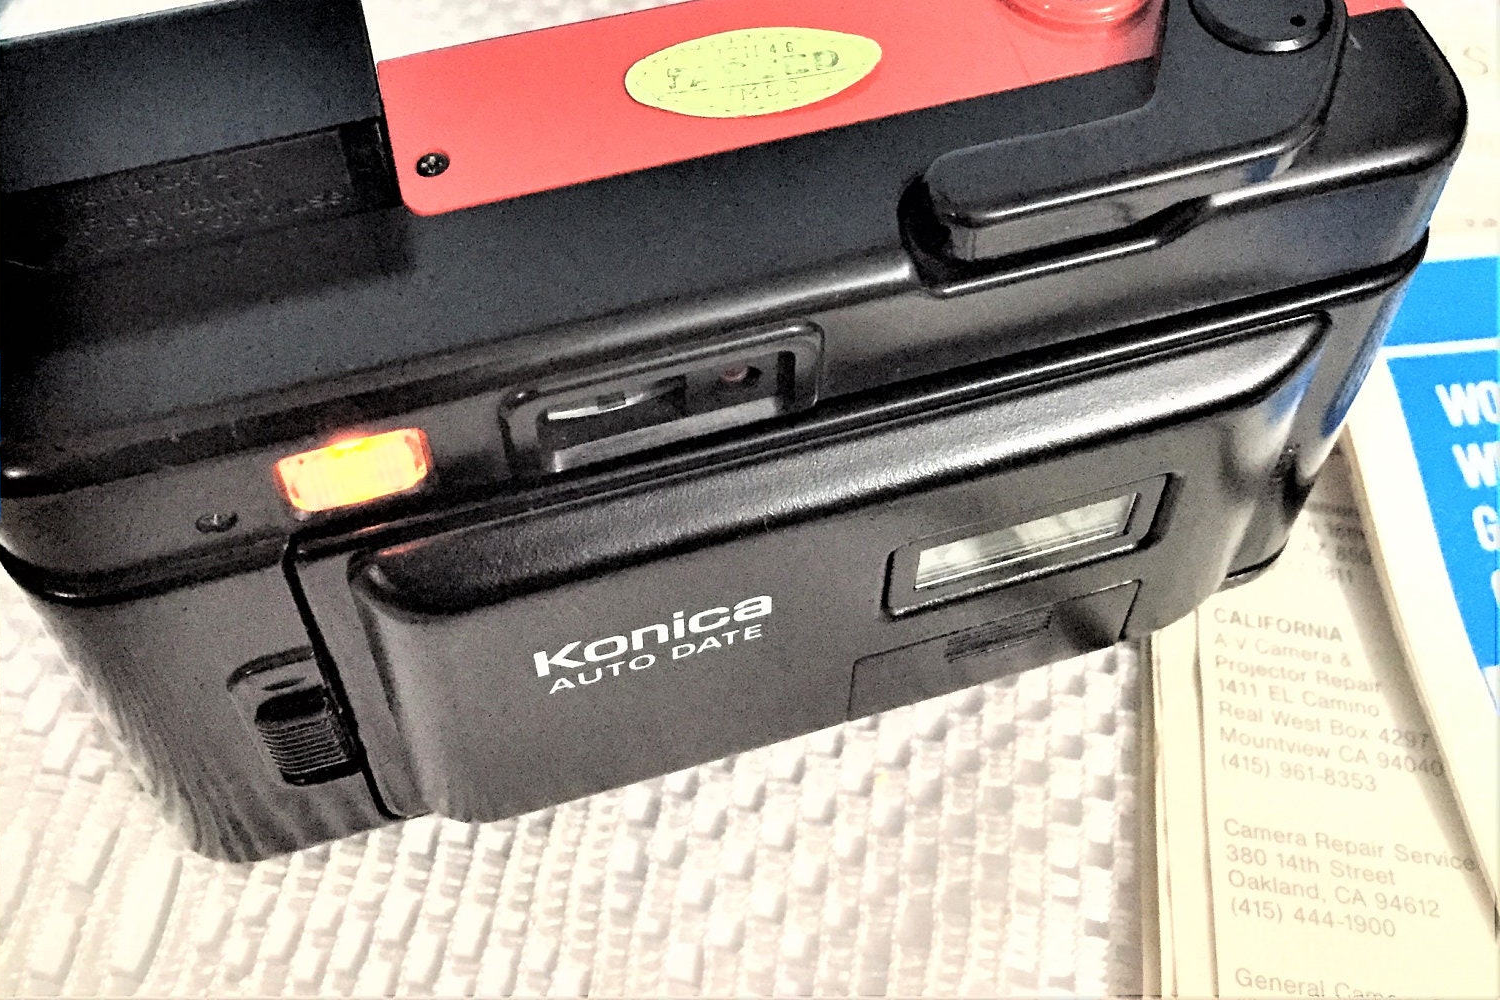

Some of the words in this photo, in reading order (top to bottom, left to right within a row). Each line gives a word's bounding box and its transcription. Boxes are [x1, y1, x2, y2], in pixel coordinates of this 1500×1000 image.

[533, 595, 773, 677] Konica
[1213, 607, 1344, 643] CALIFORNIA
[549, 654, 656, 694] AUTO
[672, 624, 763, 660] DATE
[1255, 637, 1333, 664] Camera
[1215, 654, 1307, 682] Projector
[1316, 669, 1380, 693] Repair
[1218, 678, 1258, 698] 1411
[1301, 690, 1380, 718] Camino
[1218, 700, 1263, 723] Real
[1271, 710, 1321, 734] West
[1330, 719, 1369, 741] Box
[1219, 726, 1331, 759] Mountview
[1338, 745, 1369, 765] CA
[1377, 751, 1444, 777] 94040
[1221, 752, 1270, 778] (415)
[1279, 760, 1377, 792] 961-8353
[1223, 817, 1308, 848] Camera
[1315, 832, 1385, 858] Repair
[1393, 843, 1477, 873] Service
[1226, 844, 1267, 867] 380
[1276, 852, 1320, 874] 14th
[1330, 859, 1396, 886] Street
[1227, 868, 1327, 903] Oakland,
[1334, 886, 1368, 907] CA
[1375, 892, 1442, 919] 94612
[1230, 896, 1283, 924] (415)
[1293, 906, 1396, 938] 444-1900
[1235, 967, 1325, 998] General
